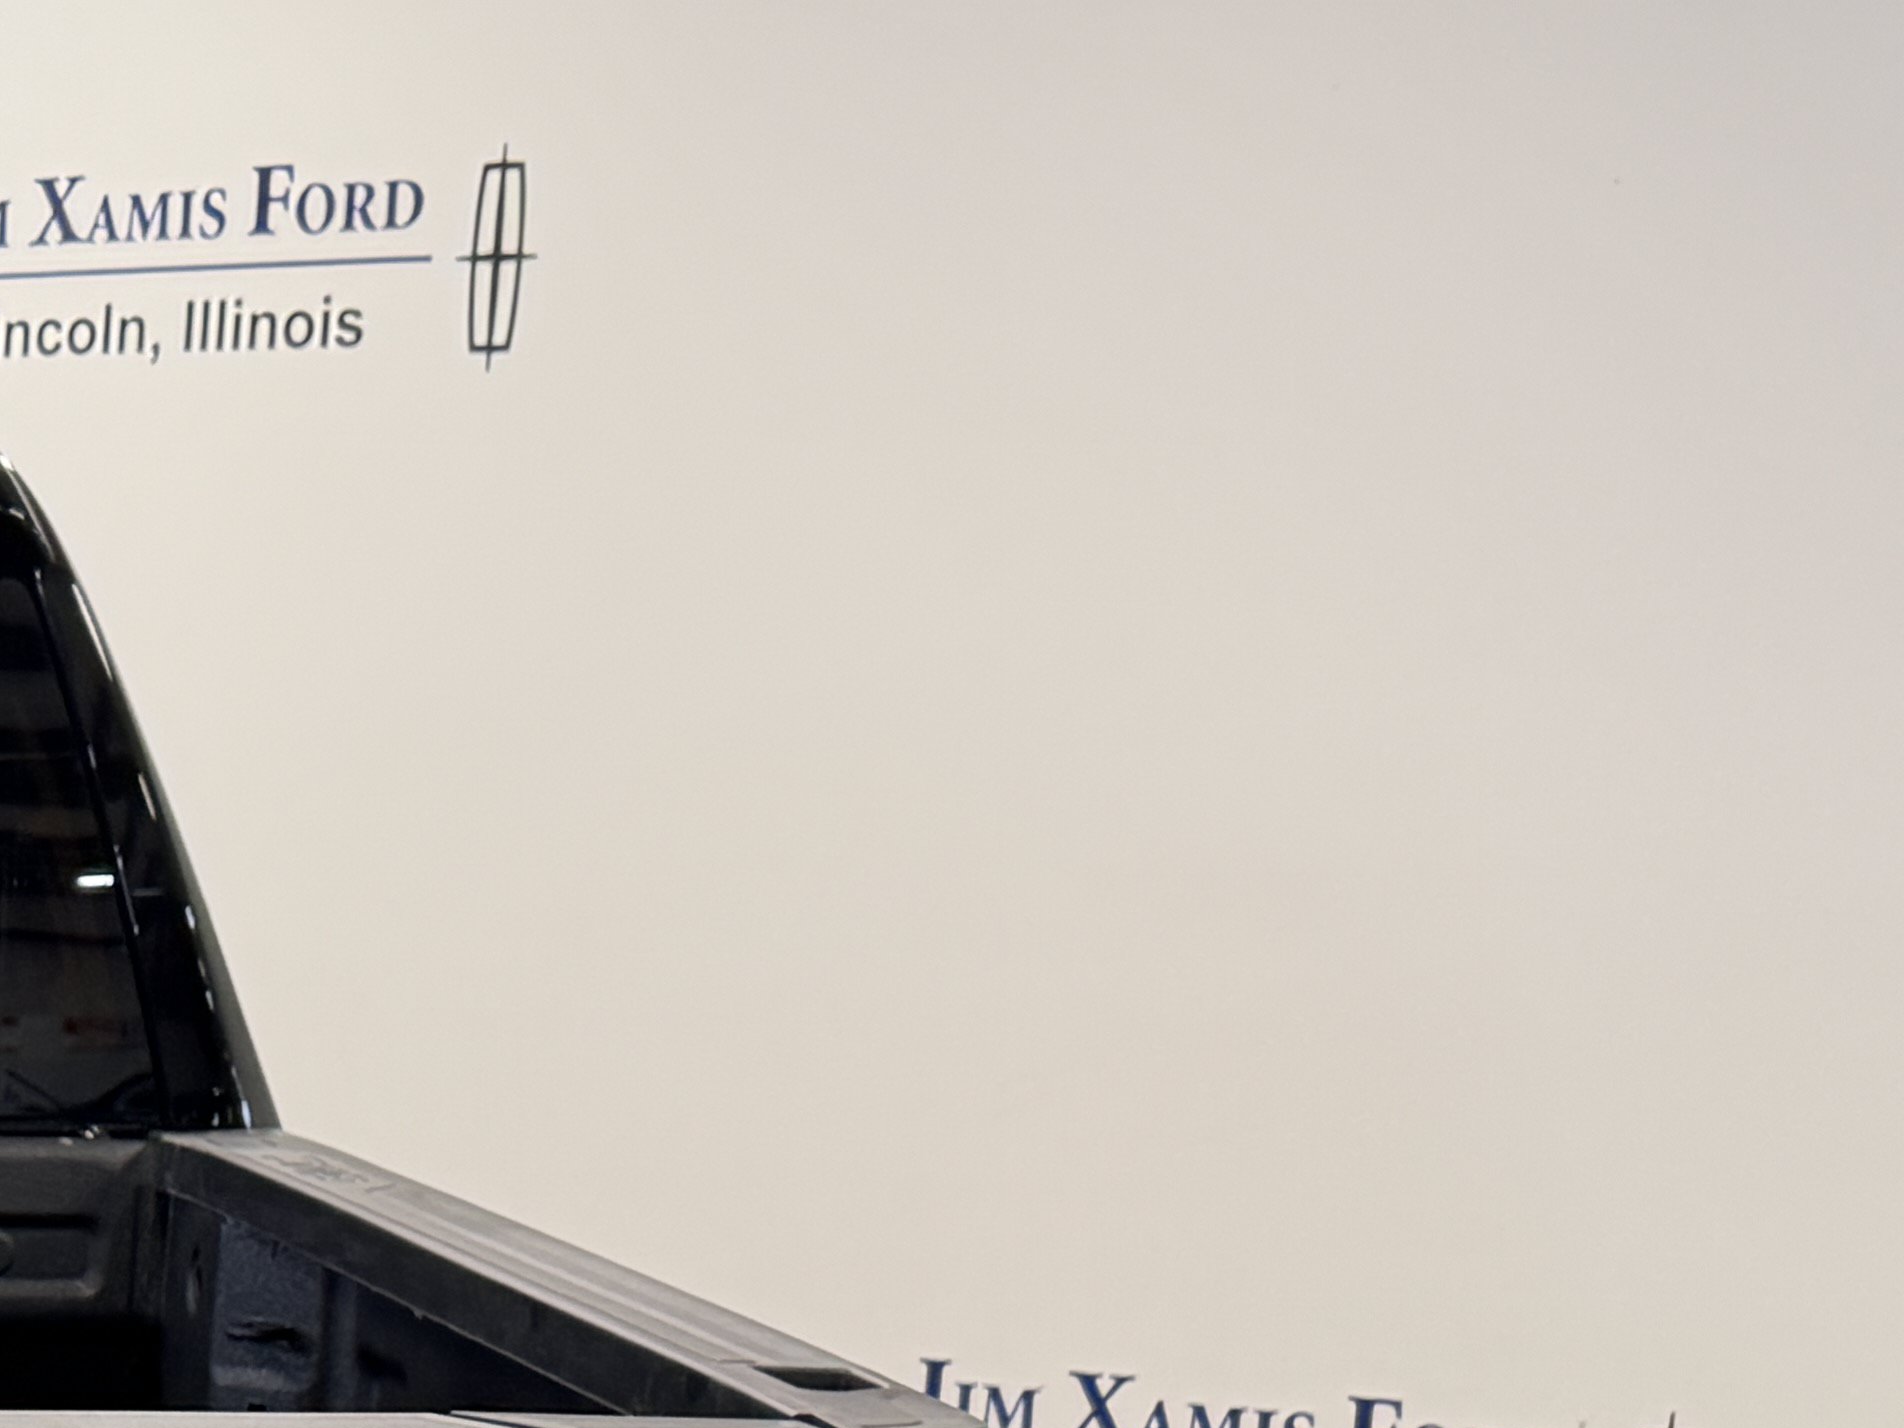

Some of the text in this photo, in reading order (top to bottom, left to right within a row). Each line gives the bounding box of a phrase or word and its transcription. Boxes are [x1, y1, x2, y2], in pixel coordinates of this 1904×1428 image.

[30, 174, 227, 247] XAMIS
[248, 163, 425, 236] FORD
[182, 294, 364, 353] Illinois
